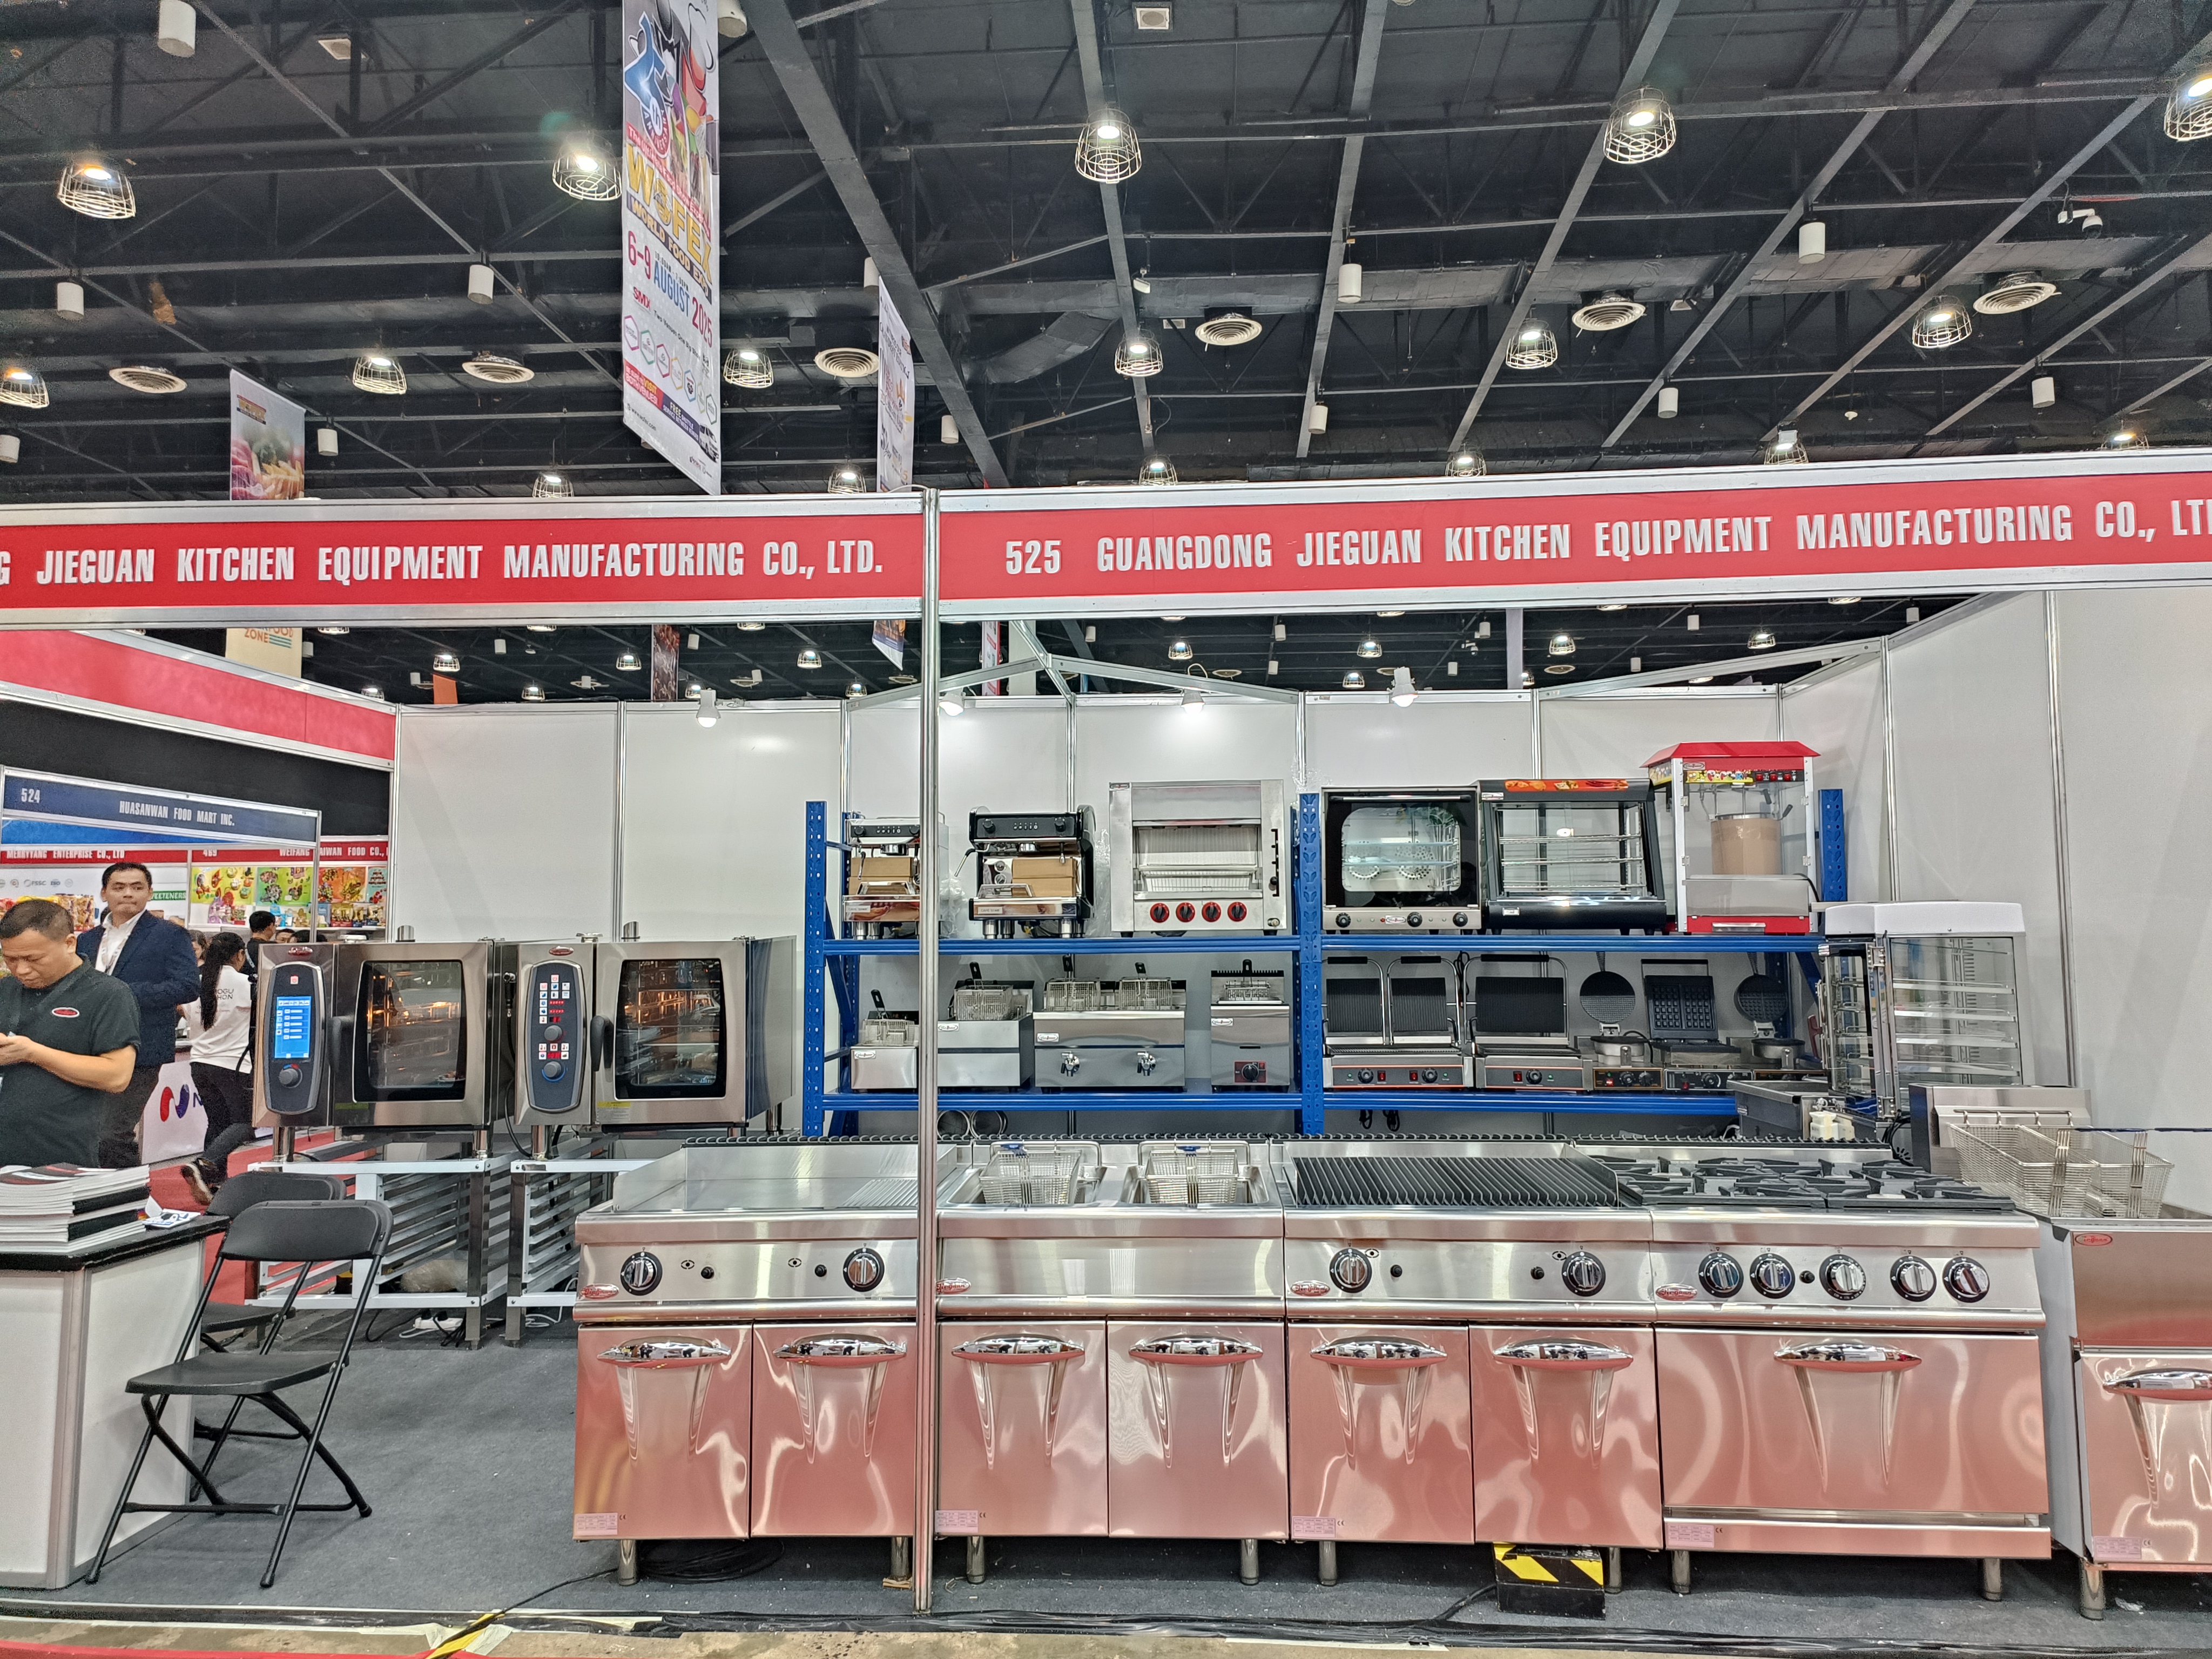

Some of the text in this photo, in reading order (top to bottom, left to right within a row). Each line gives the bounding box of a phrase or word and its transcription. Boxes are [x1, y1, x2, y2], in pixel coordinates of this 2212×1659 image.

[628, 125, 640, 147] The
[631, 195, 665, 243] WORLD
[669, 235, 690, 271] FOOD
[628, 231, 712, 348] 6-9 AUGUST 2025
[633, 286, 651, 309] SMX
[644, 379, 657, 394] VISIT
[670, 402, 682, 417] FREE
[1006, 540, 1062, 574] 525
[1098, 532, 1272, 571] GUANGDONG
[1296, 529, 1422, 567] JIEGUAN
[1445, 524, 1571, 562] KITCHEN
[1595, 516, 1772, 562] EQUIPMENT
[1797, 505, 2072, 549] MANUFACTURING
[2095, 501, 2155, 544] CO.,
[37, 549, 154, 584] JIEGUAN
[178, 547, 294, 582] KITCHEN
[319, 545, 483, 585] EQUIPMENT
[504, 542, 744, 578] MANUFACTURING
[763, 541, 815, 579] CO.,
[827, 540, 883, 574] LTD.
[245, 628, 269, 643] ZONE
[21, 788, 41, 804] 524
[119, 800, 234, 826] HUASANWAN FOOD MART INC.
[53, 850, 92, 859] ENTERPRISE
[320, 847, 342, 856] AIWAN
[348, 847, 366, 856] FOOD
[369, 847, 384, 857] CO.,
[936, 1282, 966, 1291] Jieguan
